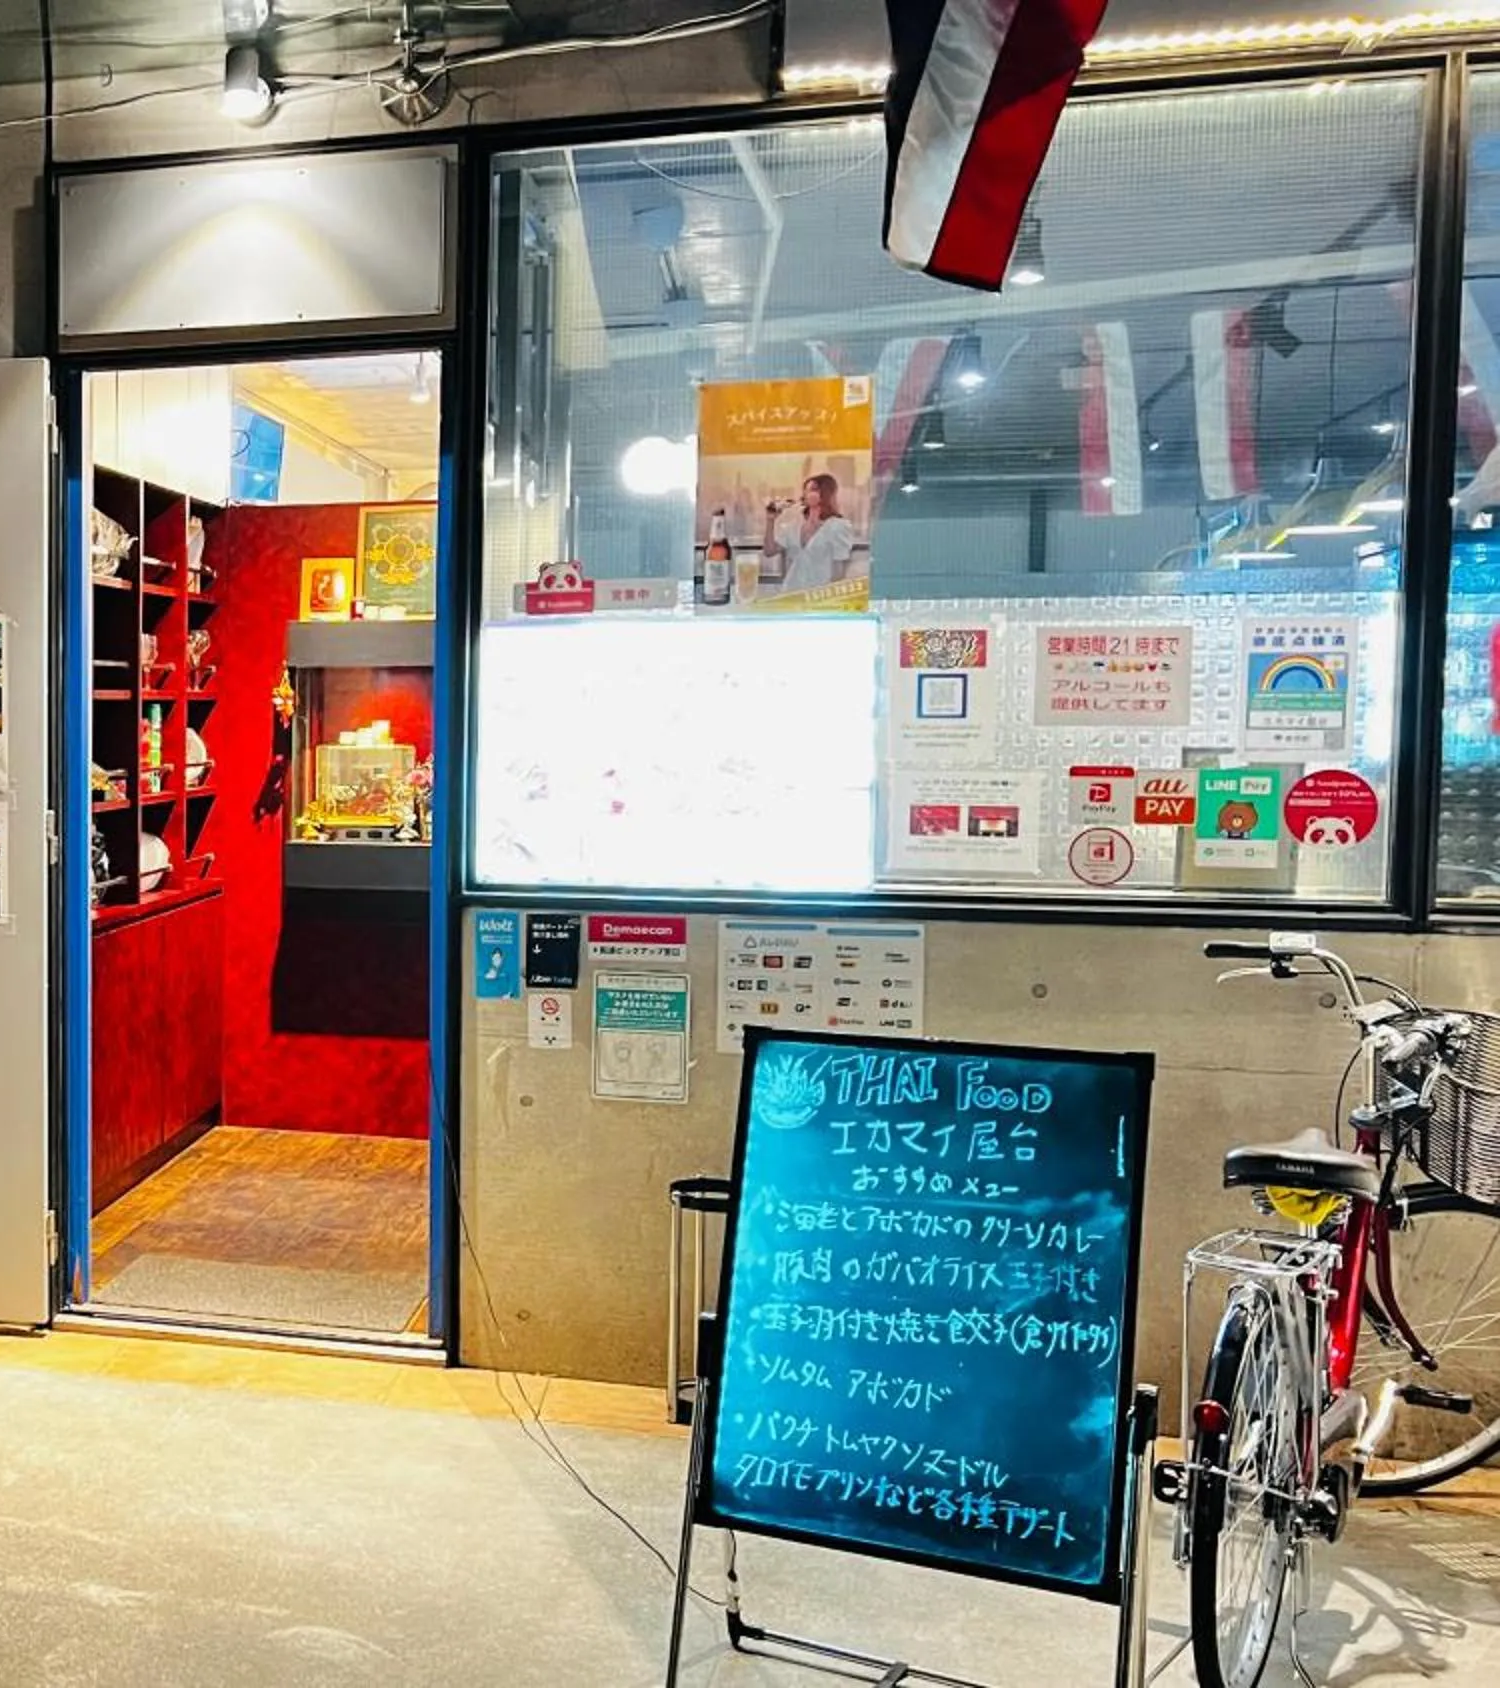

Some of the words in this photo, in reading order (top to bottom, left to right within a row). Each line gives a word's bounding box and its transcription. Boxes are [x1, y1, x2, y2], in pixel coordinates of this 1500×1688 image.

[1047, 635, 1180, 656] 営業時間21時まで
[1051, 679, 1172, 694] アルコールも
[1051, 697, 1171, 711] 提供してます
[1143, 778, 1189, 794] au
[1205, 779, 1238, 792] LINE
[1243, 780, 1268, 794] Pay
[1145, 799, 1185, 816] PAY
[479, 918, 514, 932] Wolt
[603, 923, 673, 936] Demaecan
[830, 1053, 939, 1107] THAI
[829, 1119, 1039, 1163] エカマイ屋台
[851, 1163, 952, 1194] おすすめ
[759, 1354, 833, 1389] ソムタム
[847, 1368, 953, 1414] アボカド
